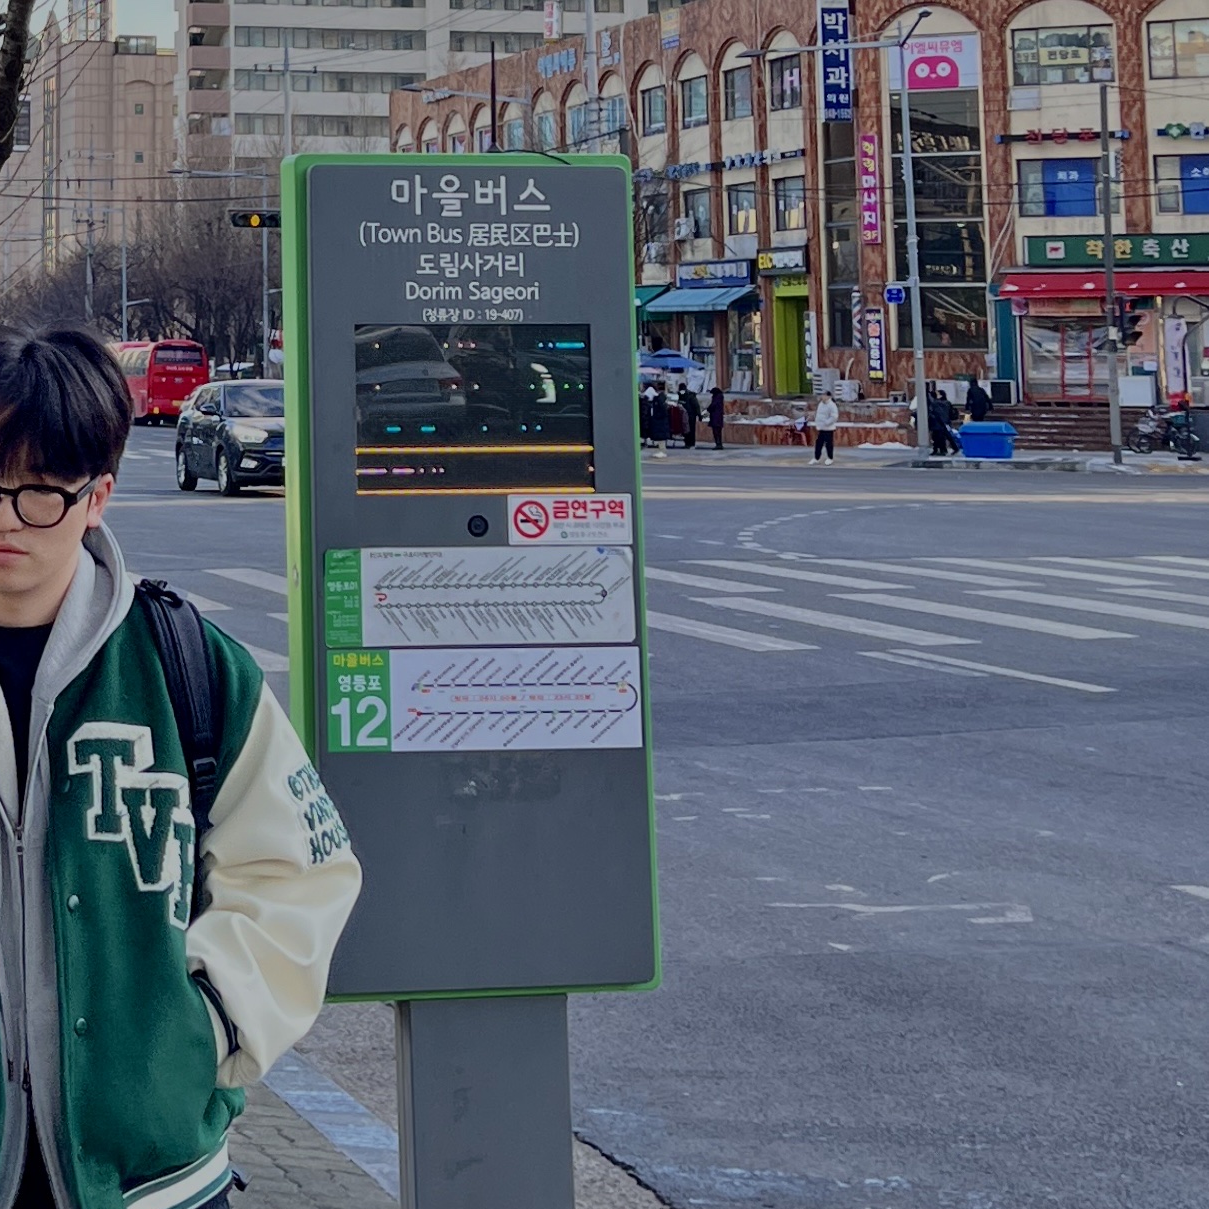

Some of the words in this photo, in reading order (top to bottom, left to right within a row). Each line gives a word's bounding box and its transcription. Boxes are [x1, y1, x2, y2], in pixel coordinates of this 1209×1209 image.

[822, 12, 848, 89] 박치과
[1047, 49, 1081, 60] 전당포
[391, 174, 551, 217] 마을버스
[359, 221, 422, 247] (Town
[427, 223, 463, 244] Bus
[468, 222, 580, 248] 居民区巴士)
[416, 252, 525, 278] 도림사거리
[405, 282, 462, 300] Dorim
[468, 282, 540, 304] Sageori
[463, 309, 475, 321] ID
[484, 308, 524, 322] 19-407)
[552, 500, 625, 519] 금연구역
[333, 655, 384, 667] 마을버스
[338, 675, 382, 693] 영등포
[331, 696, 388, 746] 12
